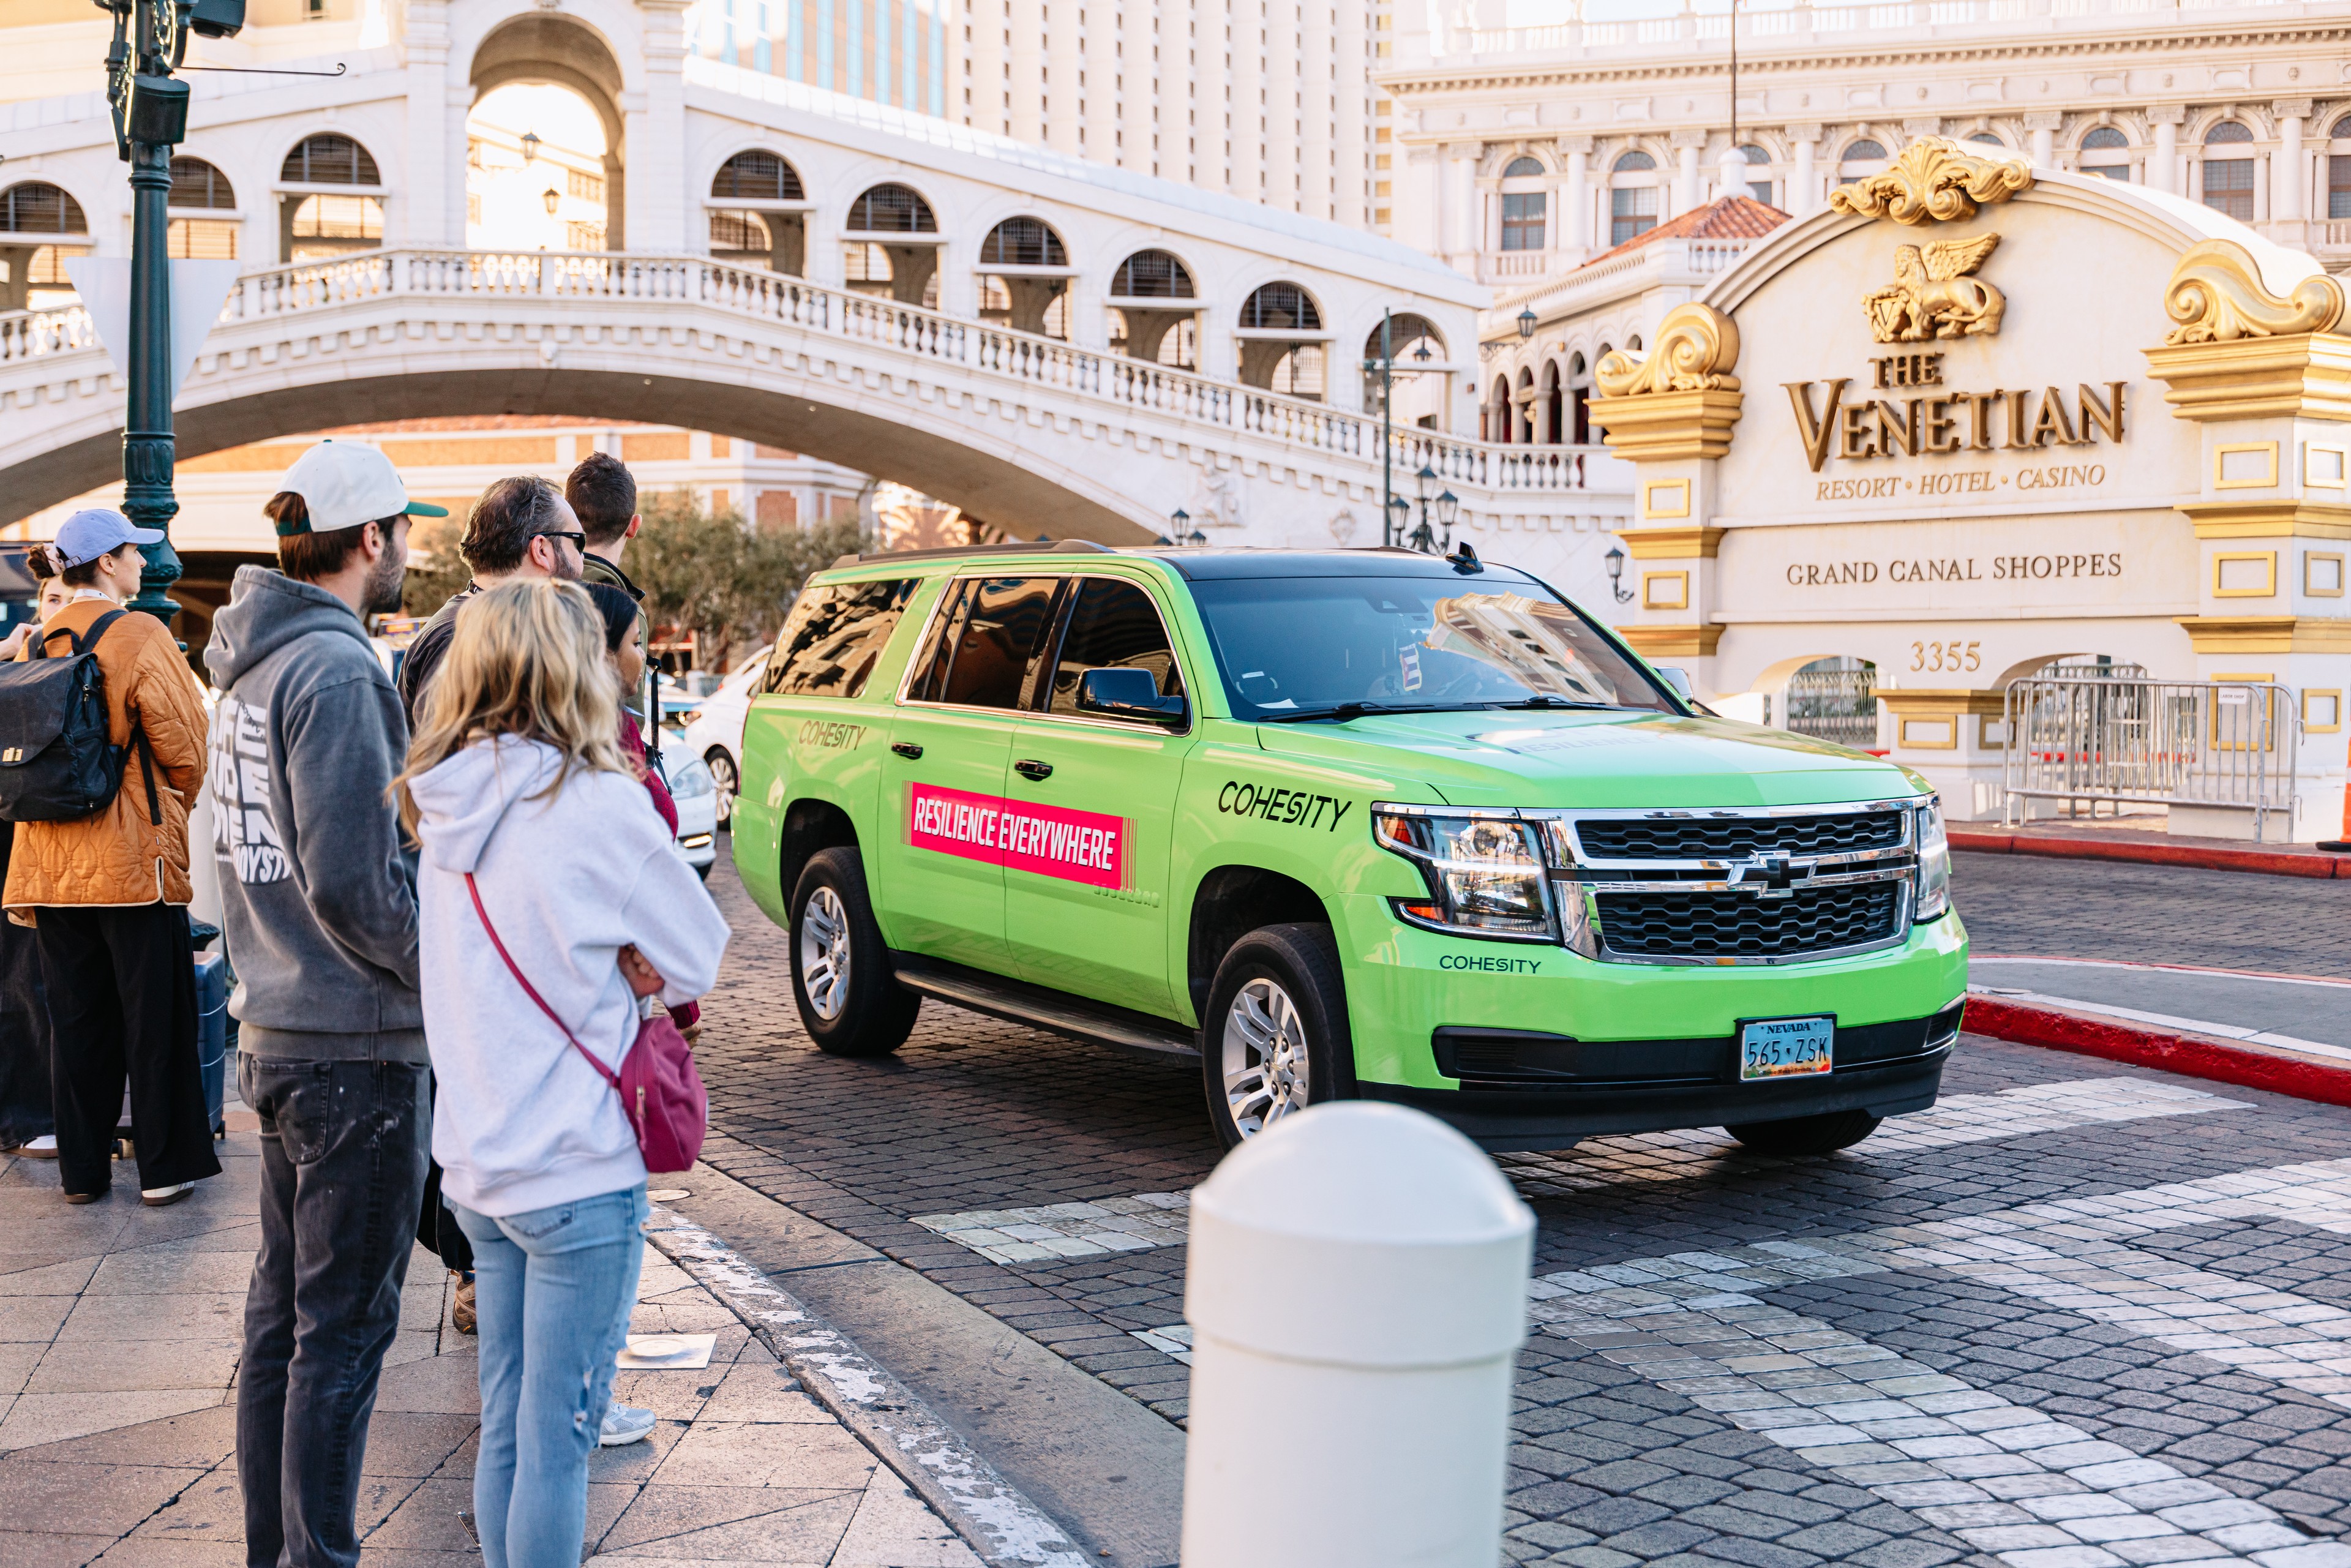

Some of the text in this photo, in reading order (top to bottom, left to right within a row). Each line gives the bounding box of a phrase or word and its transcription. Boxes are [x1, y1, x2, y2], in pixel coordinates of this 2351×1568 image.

[1867, 352, 1944, 389] THE
[1780, 378, 2128, 473] VENETIAN
[1815, 465, 2105, 501] RESORT HOTEL CASINO
[1787, 553, 2121, 585] GRAND CANAL SHOPPES
[1910, 641, 1981, 672] 3355
[212, 696, 268, 759] IFE
[799, 720, 867, 751] COHESITY
[1218, 781, 1352, 832] COHESITY
[914, 797, 1116, 871] RESILIENCE EVERYWHERE
[1439, 955, 1542, 974] COHESITY
[1767, 1022, 1811, 1033] NEVADA
[1748, 1036, 1828, 1067] 565 ZSK
